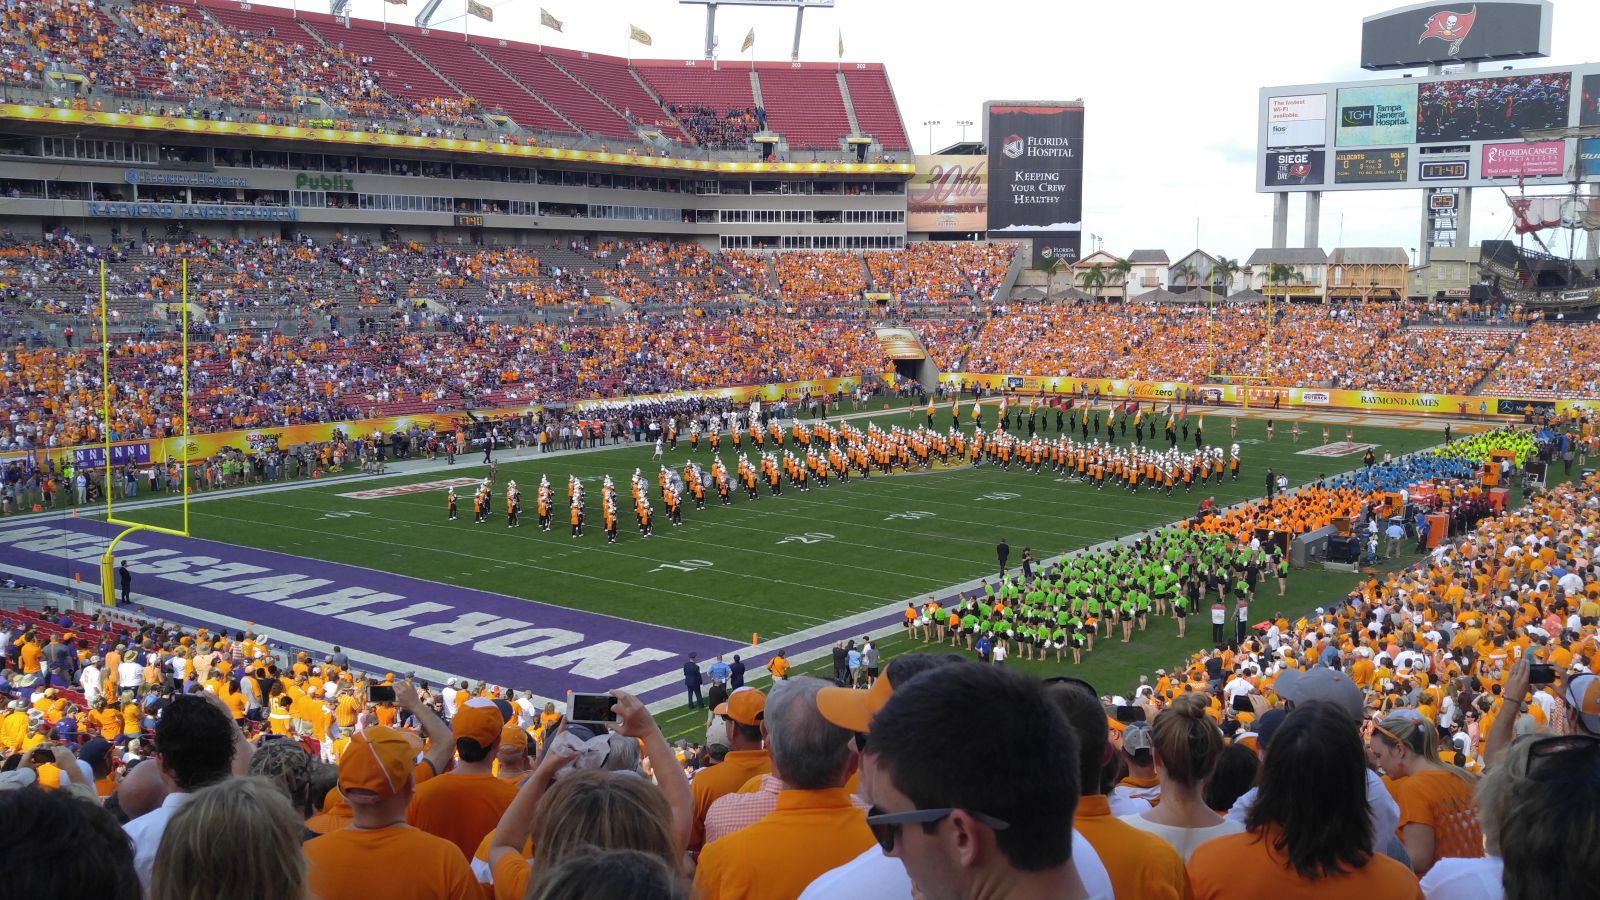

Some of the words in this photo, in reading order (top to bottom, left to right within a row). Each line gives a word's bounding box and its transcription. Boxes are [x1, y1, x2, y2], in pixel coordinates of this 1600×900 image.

[1375, 104, 1402, 114] Tampa
[1348, 110, 1372, 120] TGH
[1375, 110, 1406, 119] General
[1027, 136, 1069, 146] FLORIDA
[1027, 146, 1074, 158] HOSPITAL
[1336, 153, 1365, 161] WILDCATS
[1498, 148, 1527, 157] FLORIDA
[1528, 147, 1558, 155] CANCER
[1278, 154, 1309, 164] SIEGE
[1428, 165, 1464, 176] 17:40
[1014, 171, 1060, 181] KEEPING
[295, 172, 354, 192] Publix
[911, 161, 986, 203] 30th
[1010, 183, 1035, 192] YOUR
[1038, 182, 1067, 192] CREW
[1014, 194, 1061, 204] HEALTHY
[88, 201, 175, 218] RAYMOND
[179, 203, 228, 220] JAMES
[231, 204, 300, 222] STADIUM
[1154, 388, 1173, 396] zero
[1360, 395, 1408, 406] RAYMOND
[1408, 396, 1440, 408] JAMES
[76, 450, 85, 460] N
[89, 449, 98, 460] N
[114, 446, 122, 457] N
[127, 445, 135, 455] N
[139, 444, 147, 455] N
[893, 510, 937, 521] 30
[783, 532, 836, 544] 20
[658, 558, 715, 573] 10
